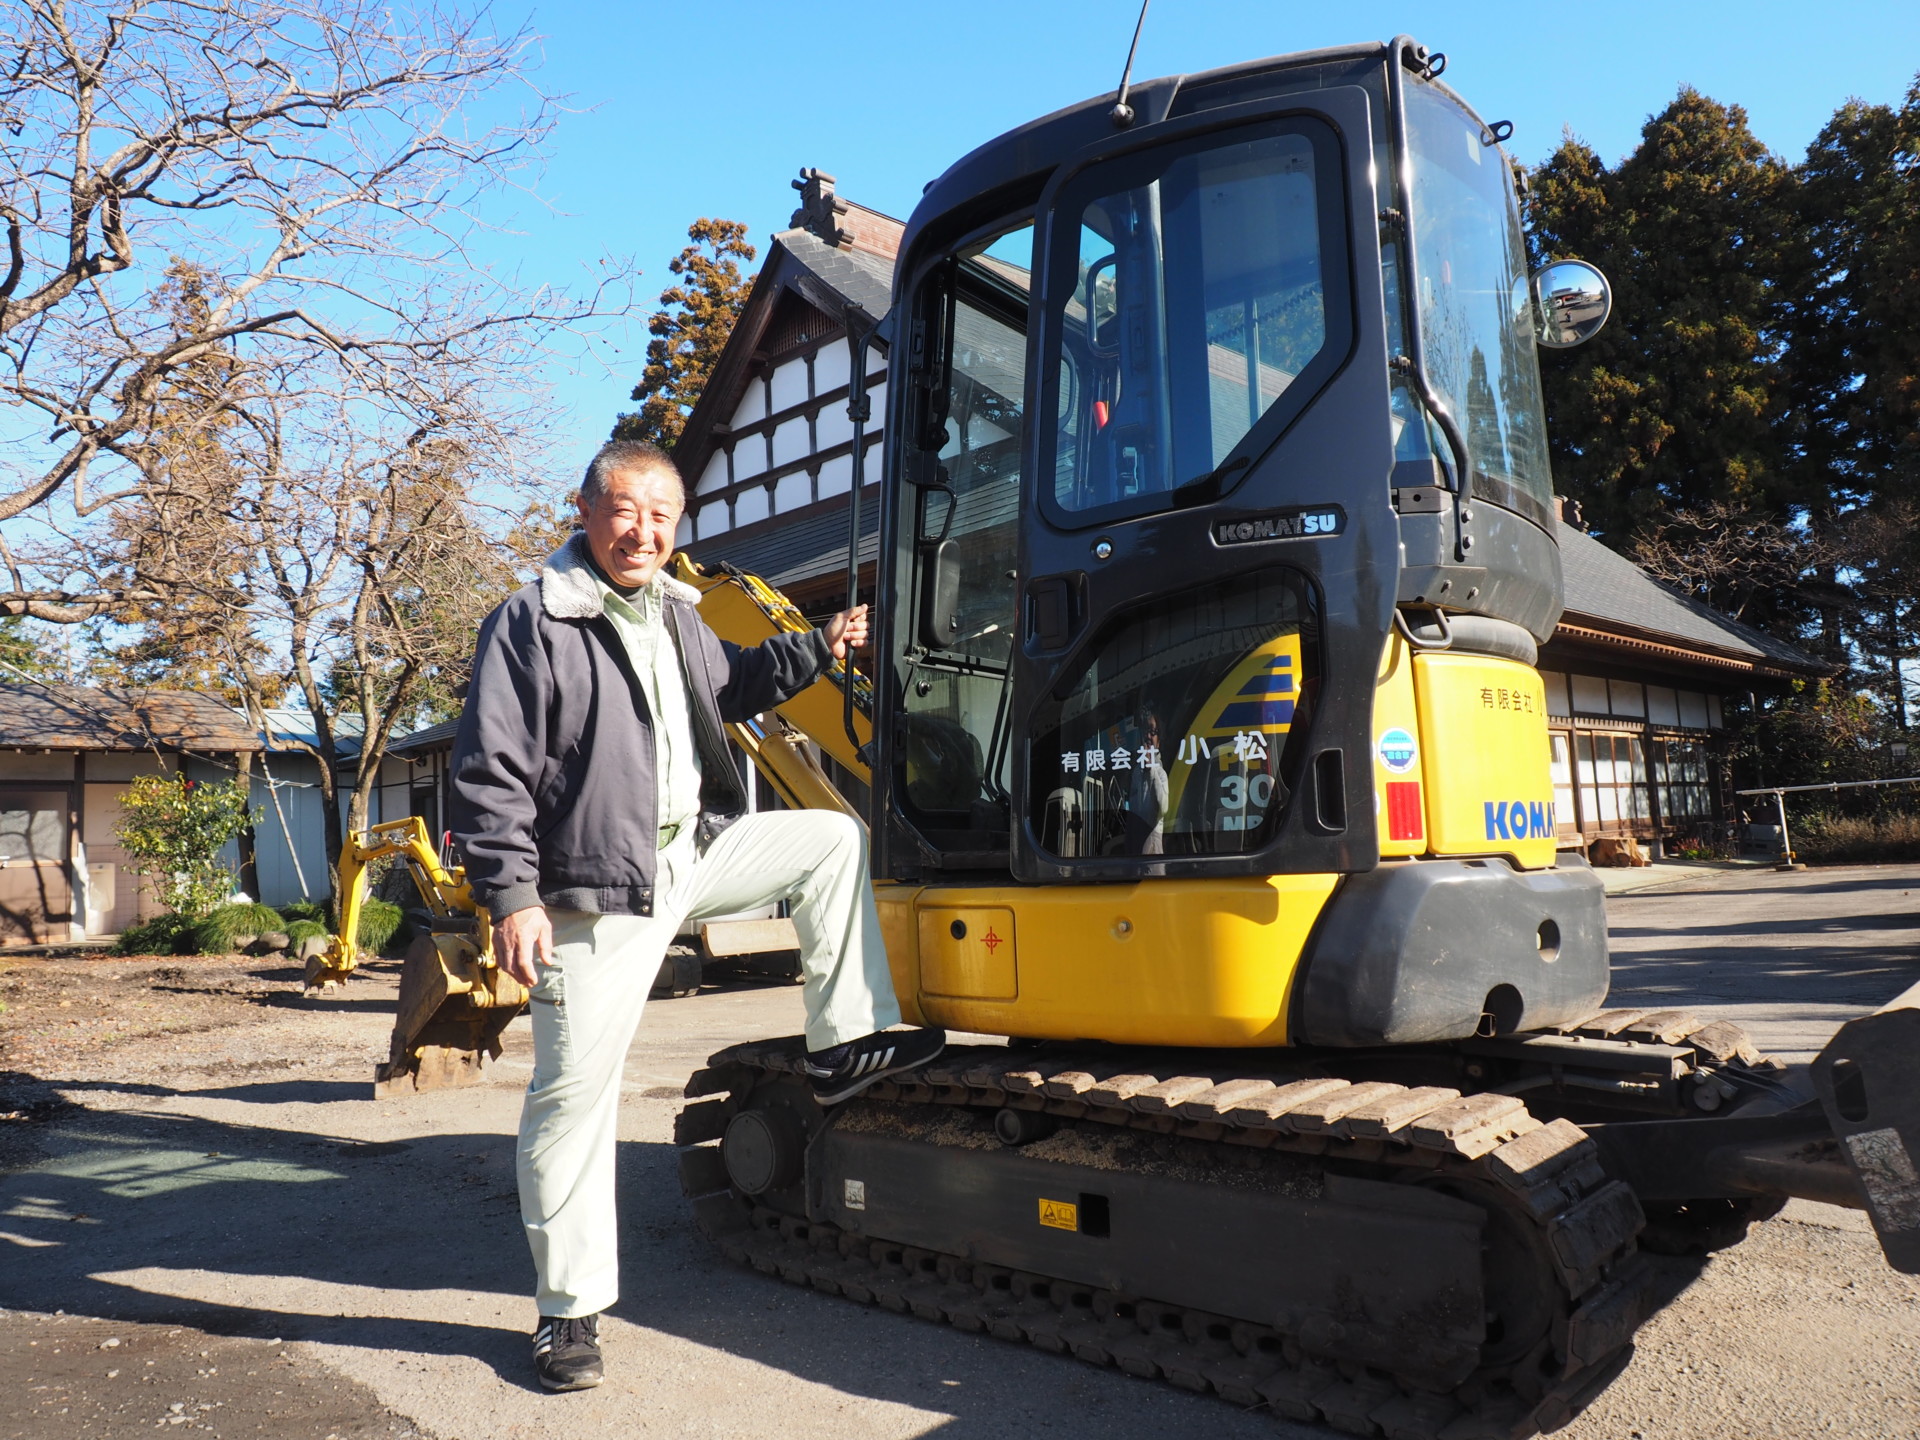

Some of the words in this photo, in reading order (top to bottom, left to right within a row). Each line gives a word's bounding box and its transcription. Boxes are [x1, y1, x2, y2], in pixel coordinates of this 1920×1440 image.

[1219, 512, 1336, 541] KOMATSU
[1480, 687, 1533, 713] 有限会社
[1061, 745, 1160, 773] 有限会社
[1178, 730, 1267, 765] 小松
[1220, 774, 1275, 809] 30
